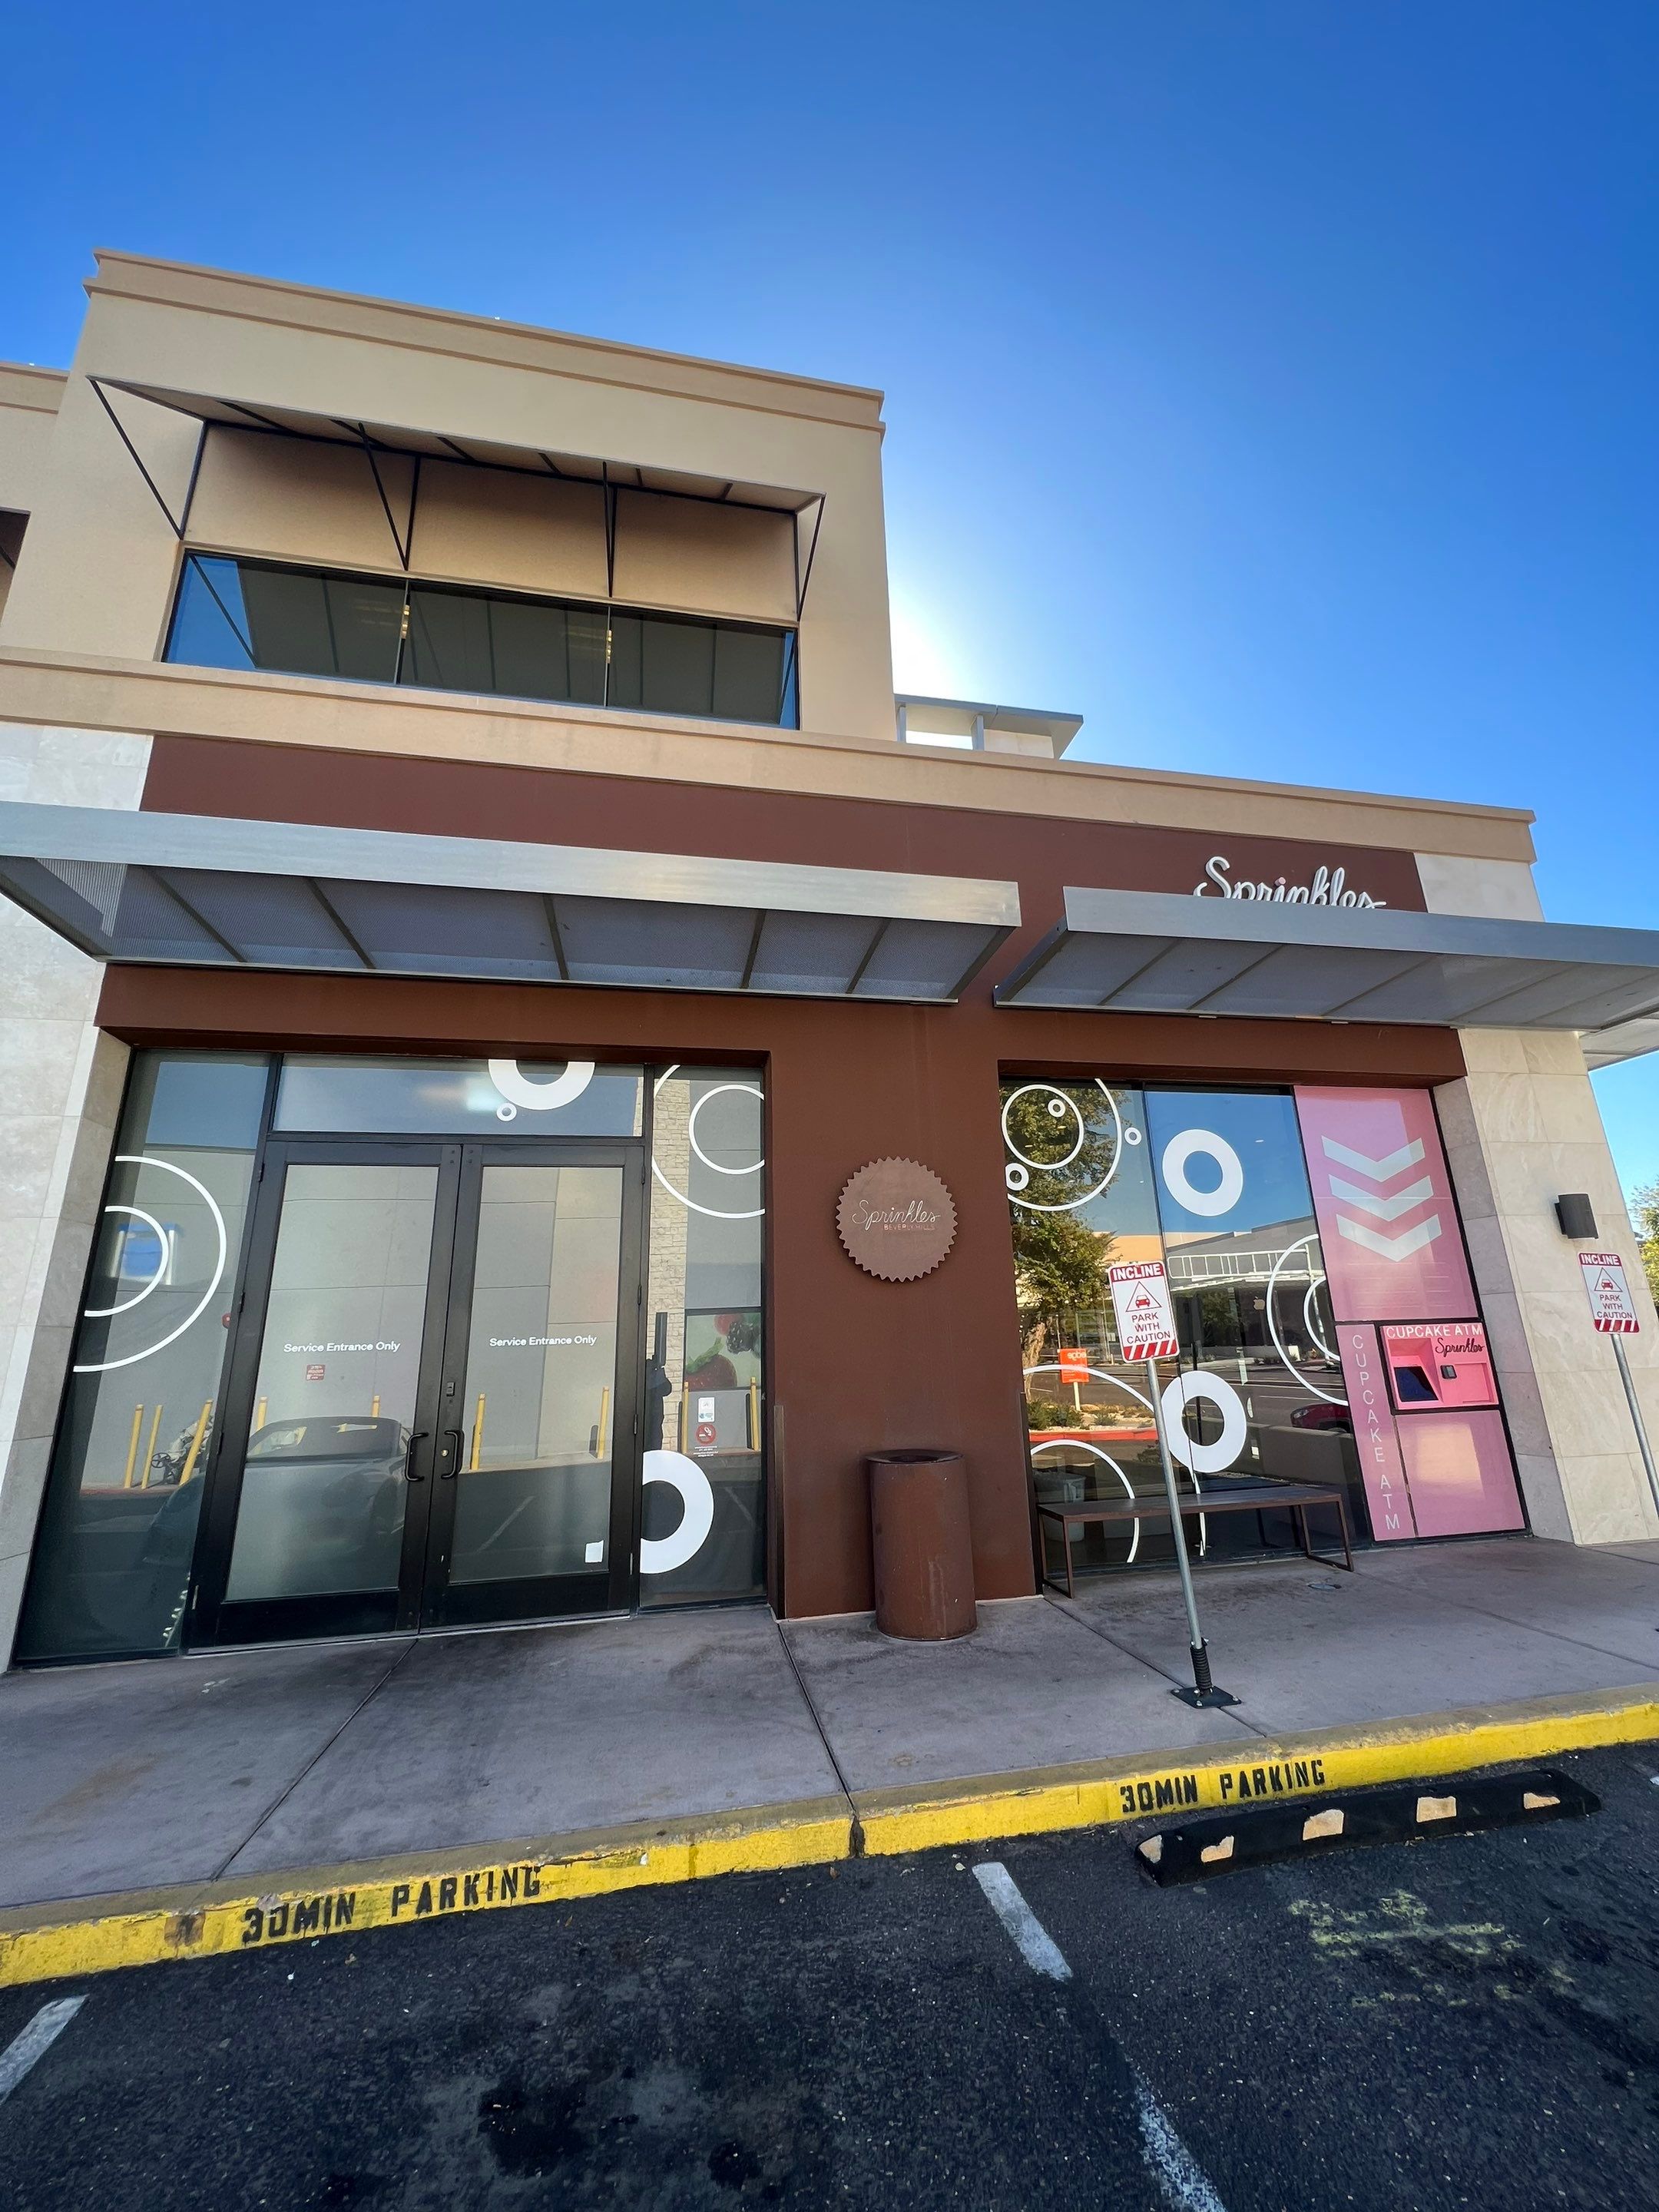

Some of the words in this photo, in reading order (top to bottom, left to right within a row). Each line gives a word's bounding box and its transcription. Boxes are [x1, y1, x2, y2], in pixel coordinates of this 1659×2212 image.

[852, 1200, 941, 1230] Sprinkles
[1581, 1253, 1620, 1266] INCLINE
[1113, 1264, 1161, 1281] INCLINE
[1131, 1312, 1159, 1323] PARK
[1134, 1322, 1160, 1333] WITH
[1386, 1325, 1452, 1338] CUPCAKE
[1455, 1324, 1482, 1336] ATM
[489, 1337, 527, 1346] Service
[528, 1336, 572, 1346] Entrance
[574, 1335, 597, 1346] Only
[1127, 1330, 1171, 1344] CAUTION
[283, 1343, 324, 1353] Service
[326, 1342, 374, 1352] Entrance
[376, 1340, 401, 1353] Only
[1435, 1337, 1485, 1358] Sprinkles
[1353, 1335, 1386, 1462] CUPCAKE
[1379, 1474, 1401, 1531] ATM
[1119, 1774, 1198, 1813] 30MIN
[1219, 1759, 1326, 1800] PARKING
[241, 1892, 356, 1945] 30MIN
[391, 1865, 541, 1917] PARKING
